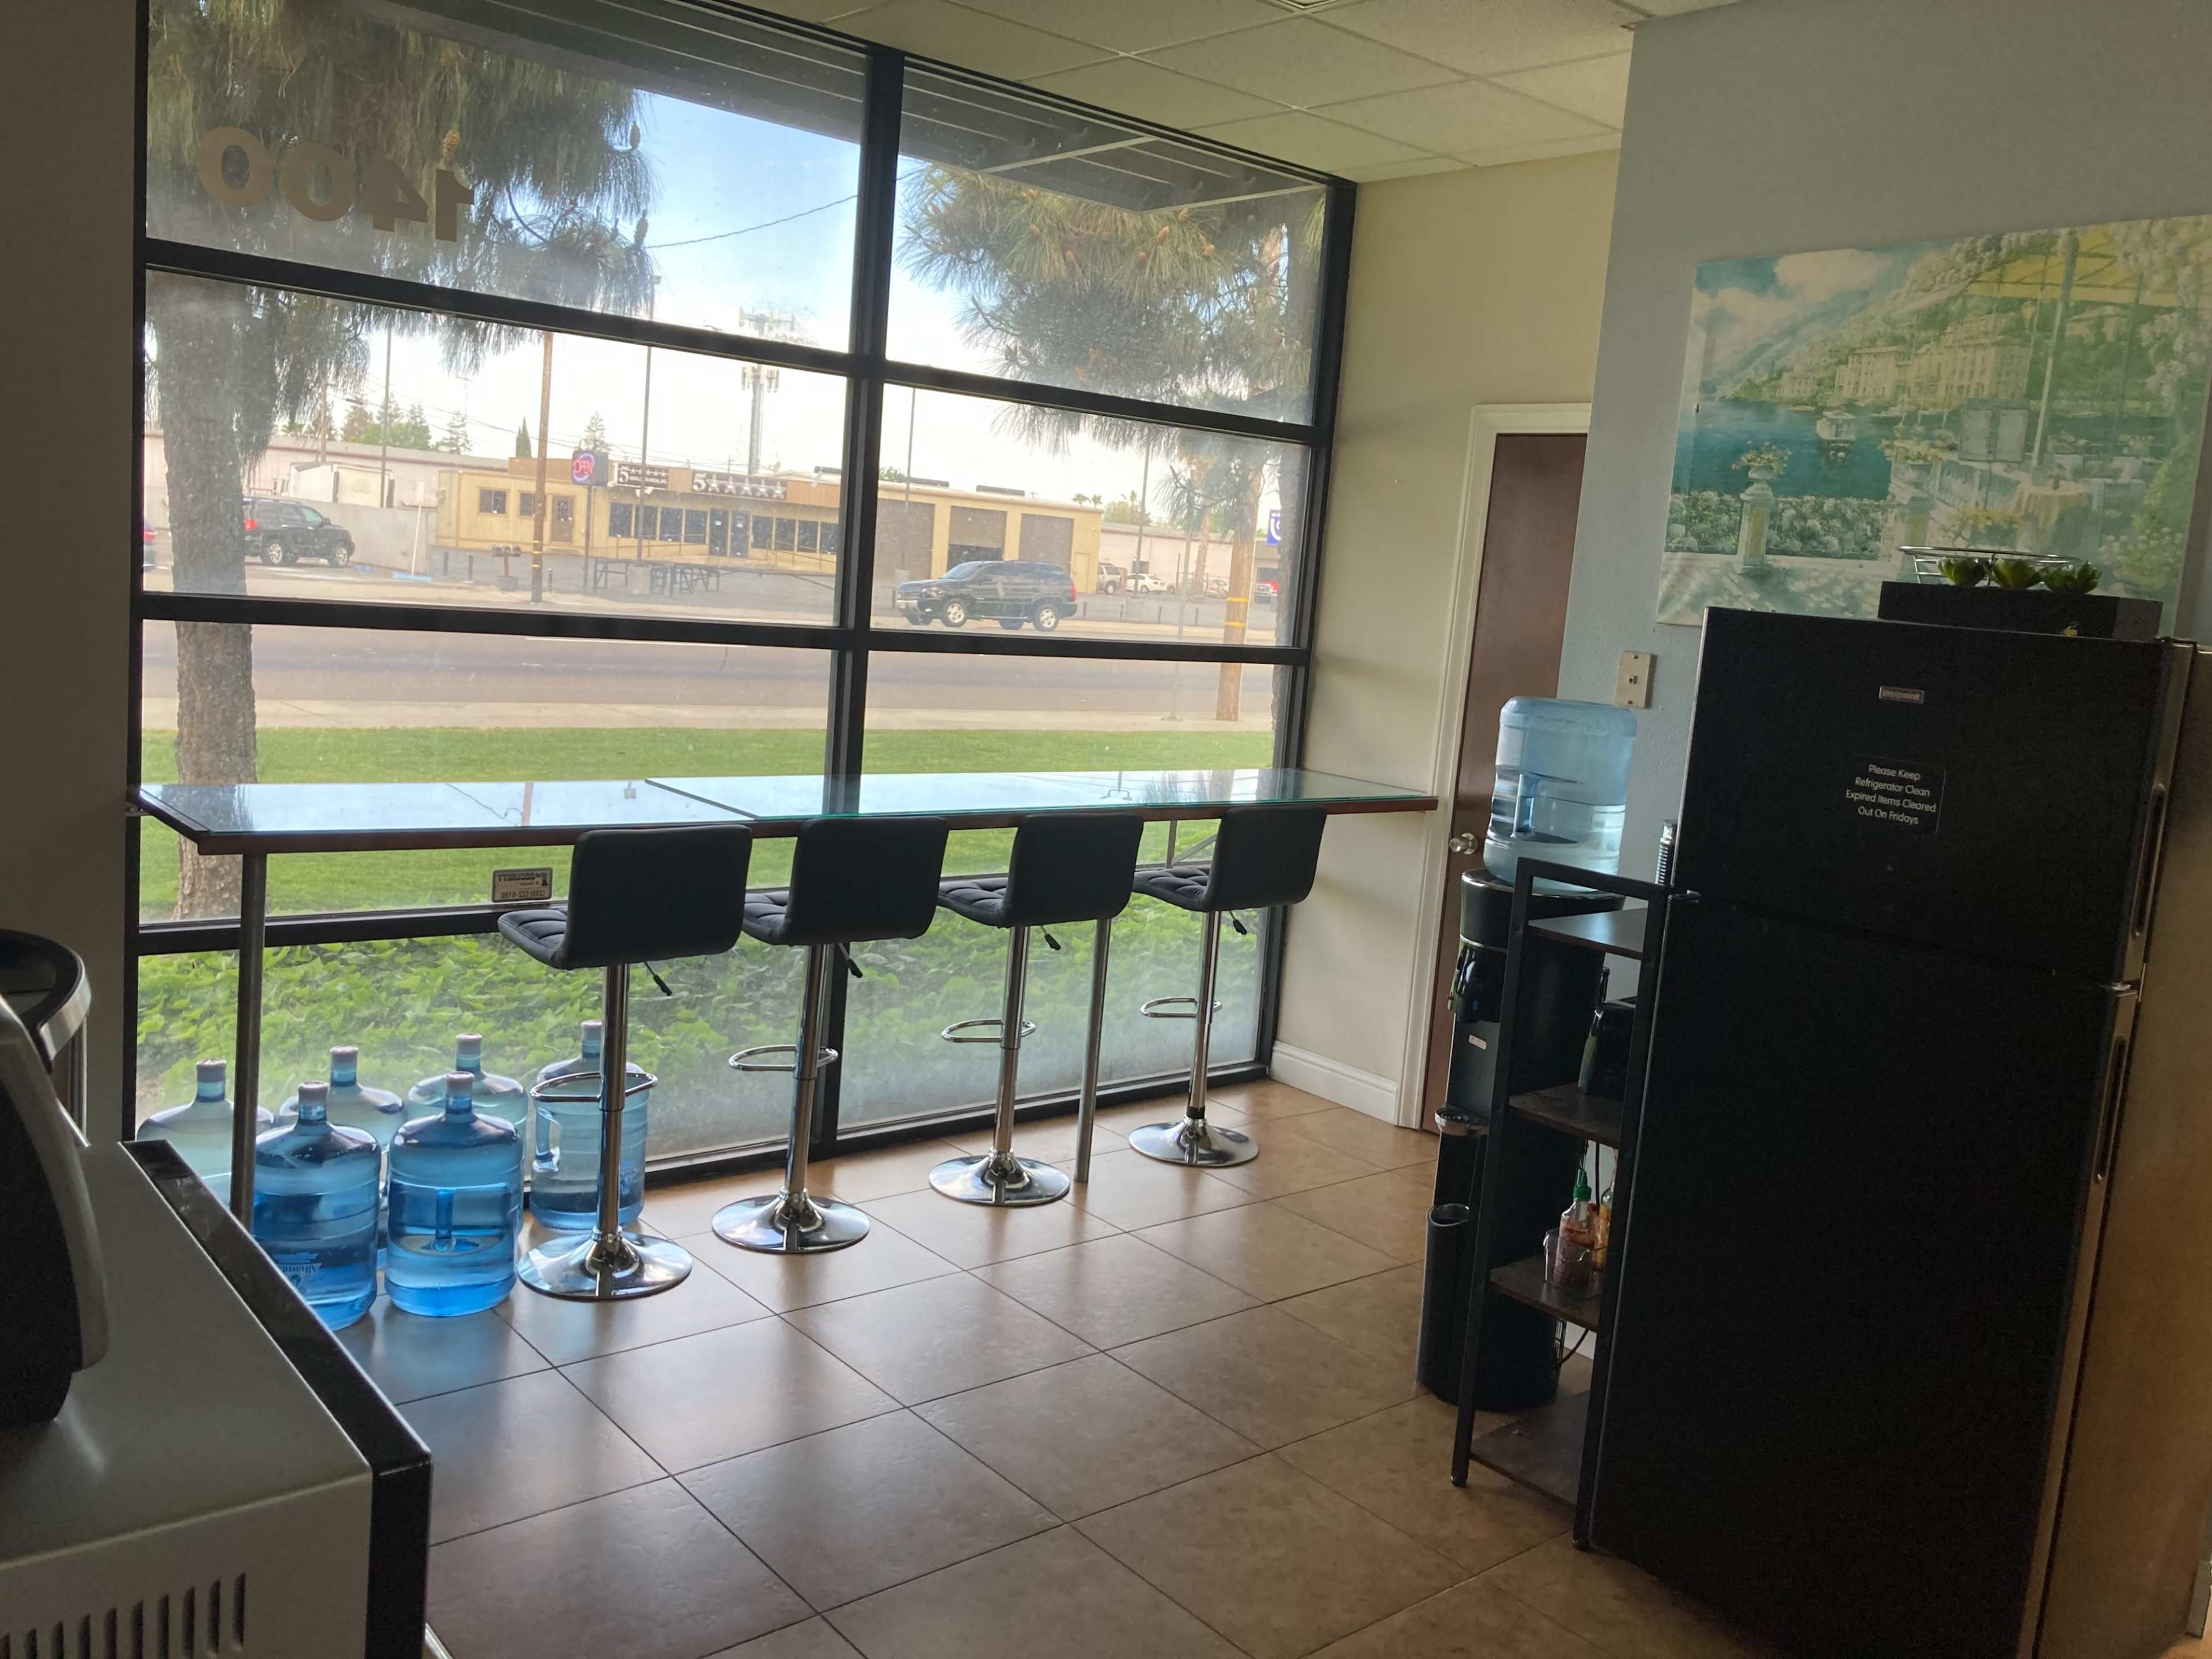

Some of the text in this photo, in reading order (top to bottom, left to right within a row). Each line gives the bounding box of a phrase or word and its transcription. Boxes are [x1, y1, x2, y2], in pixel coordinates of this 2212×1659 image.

[619, 466, 629, 483] 5
[692, 472, 707, 492] 5
[1868, 764, 1921, 782] Please Keep
[1855, 777, 1930, 797] Refrigerator Clean
[1846, 789, 1937, 812] Expired Items Cleared
[1858, 806, 1919, 825] Out On Fridays
